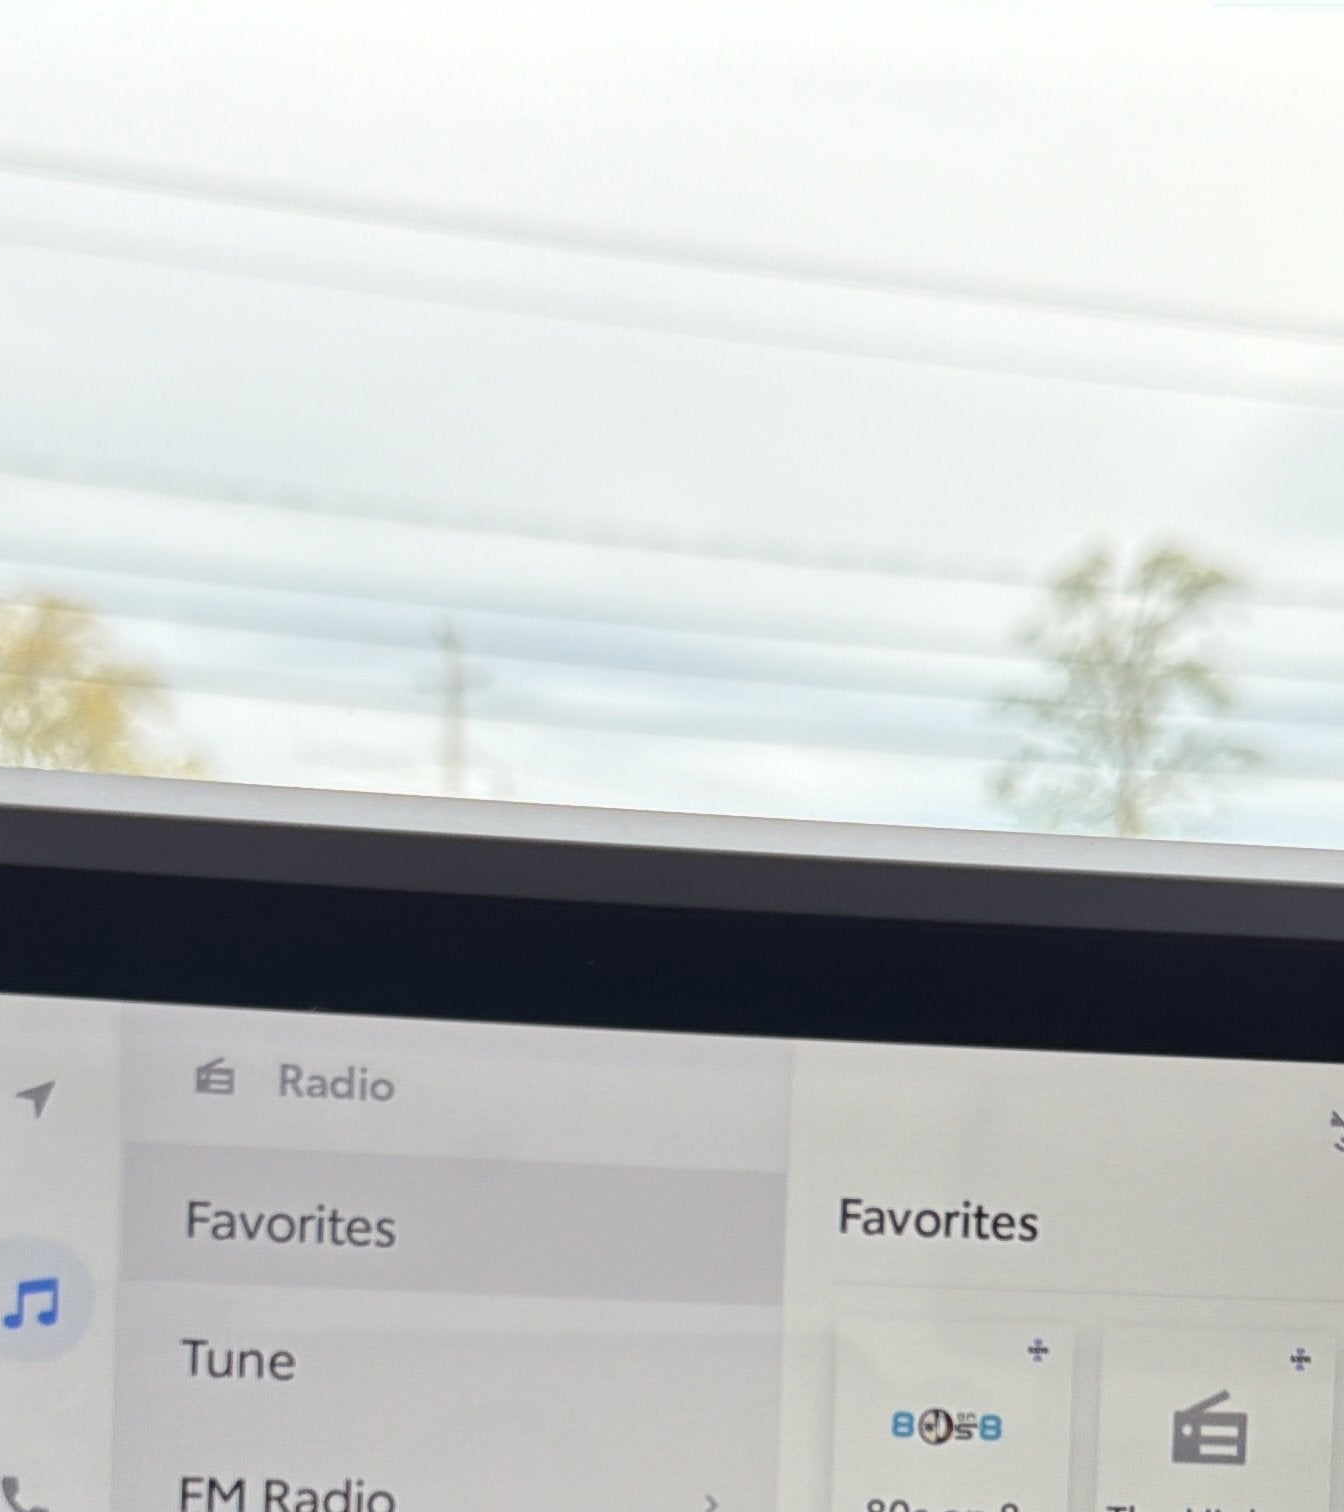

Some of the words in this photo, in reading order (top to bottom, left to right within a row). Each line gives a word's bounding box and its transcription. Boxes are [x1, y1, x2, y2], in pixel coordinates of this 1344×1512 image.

[278, 1062, 396, 1104] Radio
[185, 1201, 397, 1250] Favorites
[838, 1196, 1040, 1244] Favorites
[181, 1338, 297, 1381] Tune
